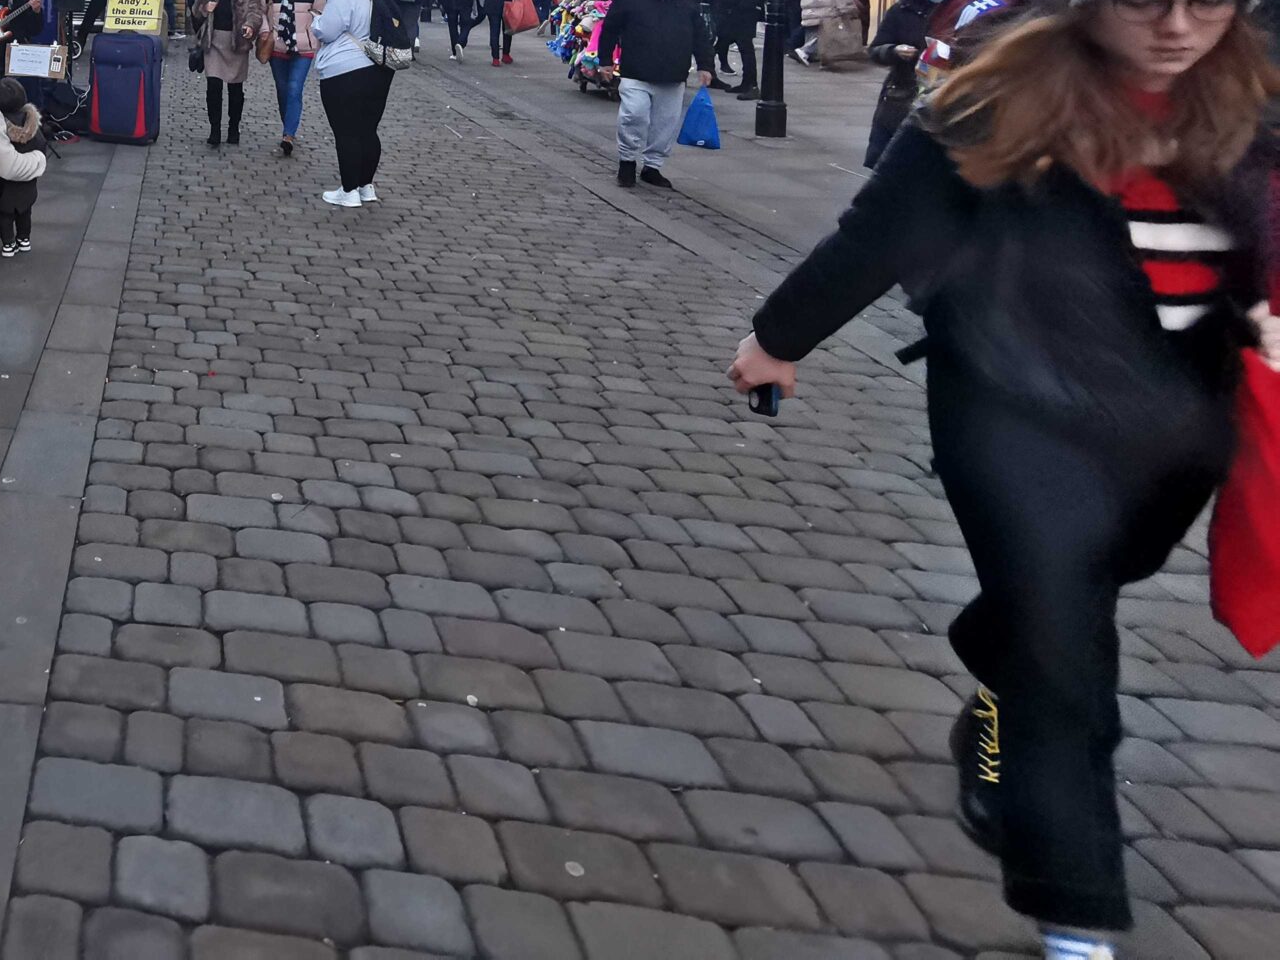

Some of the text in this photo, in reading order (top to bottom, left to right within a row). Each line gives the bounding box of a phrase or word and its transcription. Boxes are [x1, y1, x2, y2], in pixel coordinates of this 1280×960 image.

[111, 7, 153, 16] the Blind
[114, 18, 147, 26] Busker
